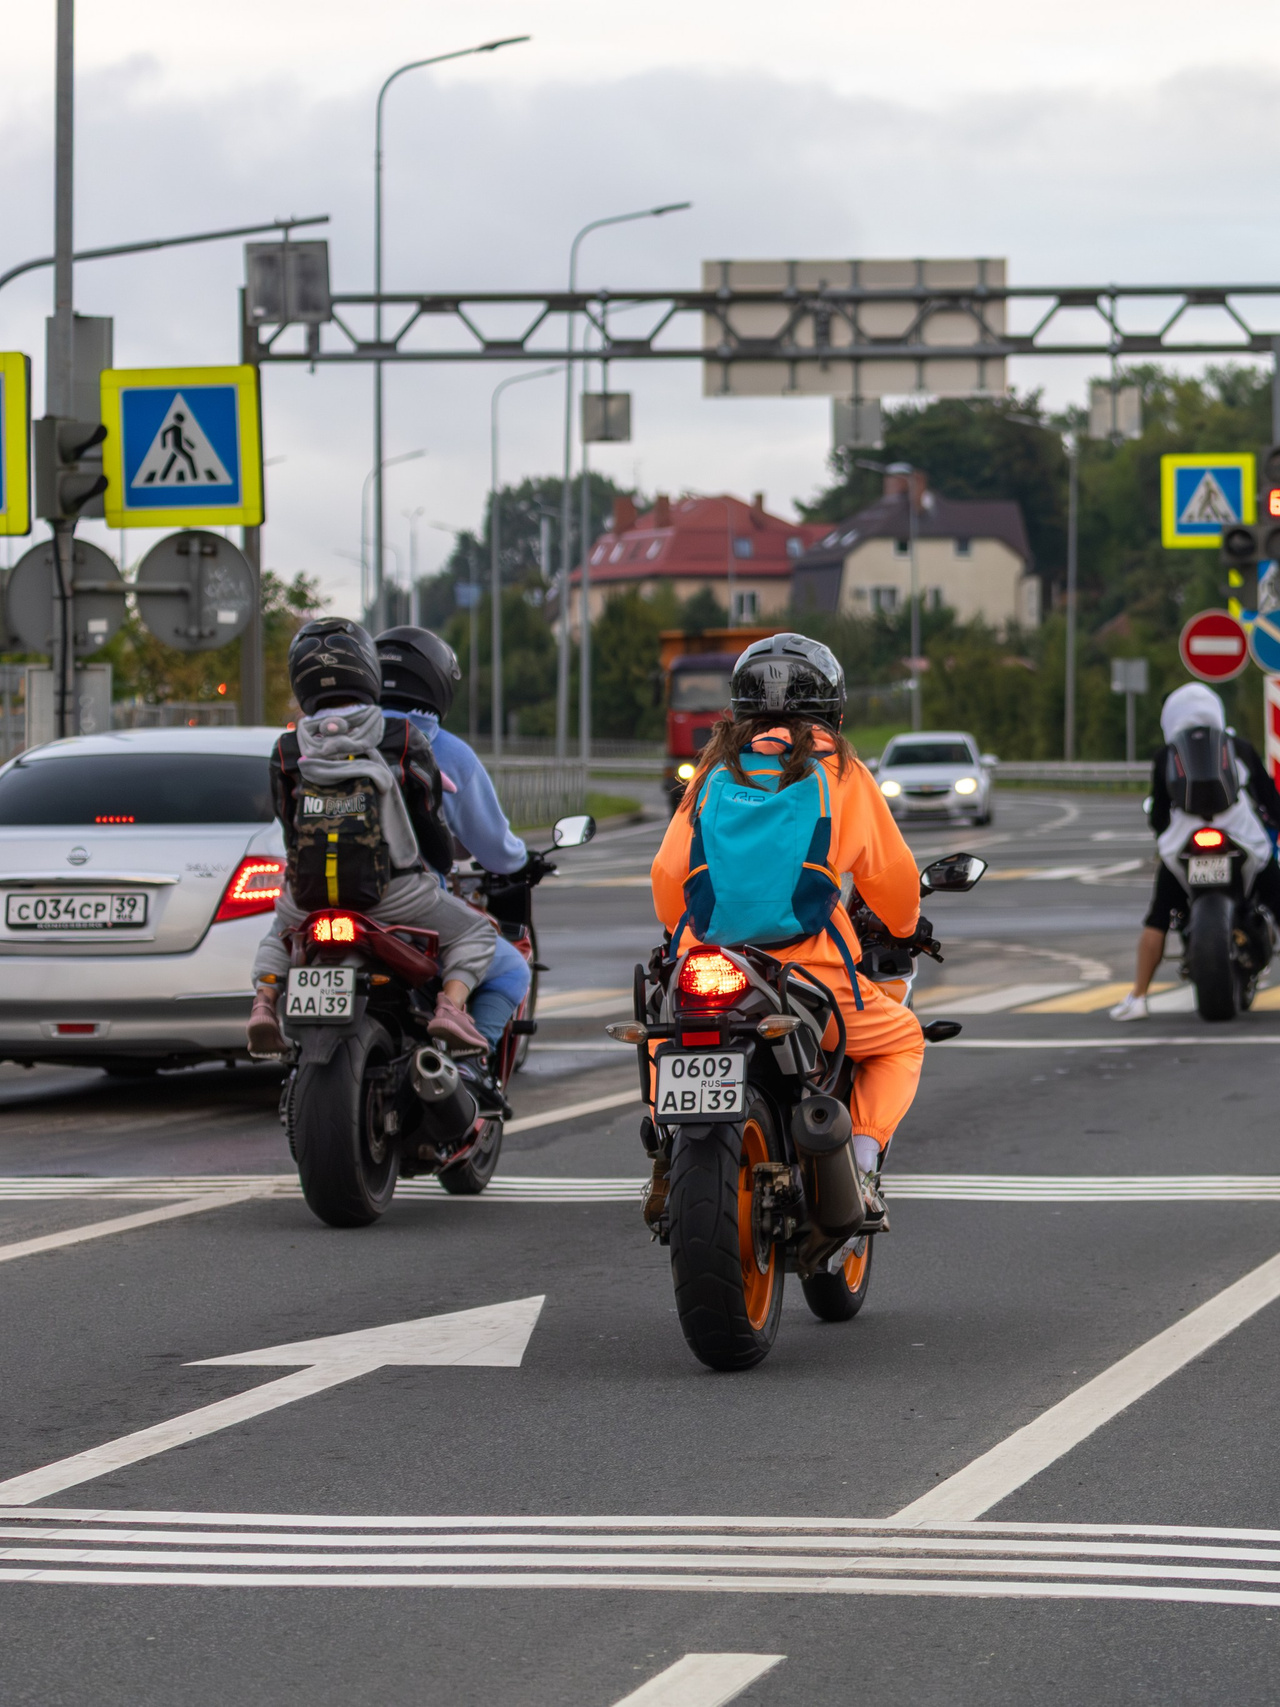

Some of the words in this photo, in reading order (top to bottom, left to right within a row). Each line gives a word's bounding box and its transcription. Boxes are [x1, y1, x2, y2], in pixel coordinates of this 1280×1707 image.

[303, 796, 323, 814] NO
[115, 897, 138, 914] 39
[297, 970, 345, 987] 8015
[289, 996, 317, 1014] AA
[324, 996, 348, 1014] 39
[671, 1056, 732, 1079] 0609
[700, 1080, 720, 1088] RUS
[660, 1090, 697, 1112] AB
[707, 1089, 737, 1111] 39
